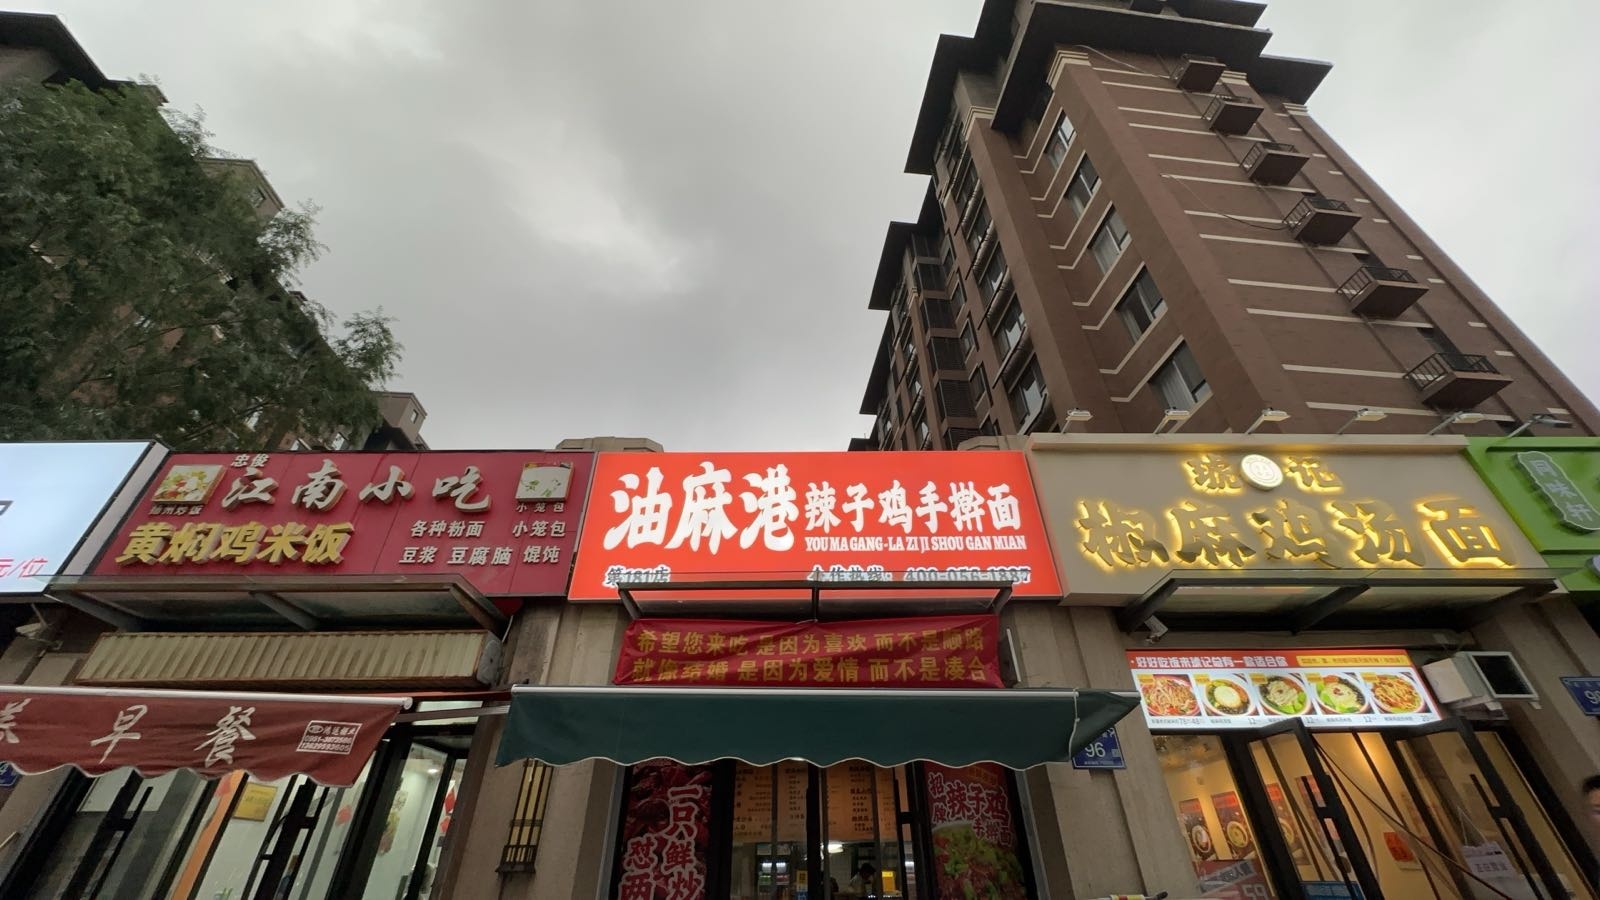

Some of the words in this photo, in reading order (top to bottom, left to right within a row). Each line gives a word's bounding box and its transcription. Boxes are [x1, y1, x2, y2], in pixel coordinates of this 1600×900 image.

[221, 458, 493, 514] 江南小吃
[516, 502, 565, 513] 小笼包
[603, 461, 800, 556] 油麻港
[804, 480, 1022, 534] 辣子鸡手擀面
[410, 519, 485, 538] 各种粉面
[512, 520, 566, 538] 小笼包
[931, 536, 965, 550] SHOU
[966, 536, 993, 550] GAN
[994, 535, 1027, 550] MIAN
[1077, 497, 1516, 568] 椒麻鸡汤面
[115, 521, 355, 567] 黄焖鸡米饭
[398, 546, 438, 565] 豆浆
[447, 546, 514, 566] 豆腐脑
[523, 545, 562, 564] 馄饨
[637, 629, 748, 656] 希望您来吃
[756, 632, 867, 656] 是因为喜欢
[874, 627, 984, 652] 而不是顺路
[631, 657, 729, 682] 就像结婚
[737, 657, 858, 682] 是因为爱情
[868, 656, 987, 682] 而不是凑合
[1085, 742, 1106, 758] 96
[946, 780, 1010, 828] 辣子鸡
